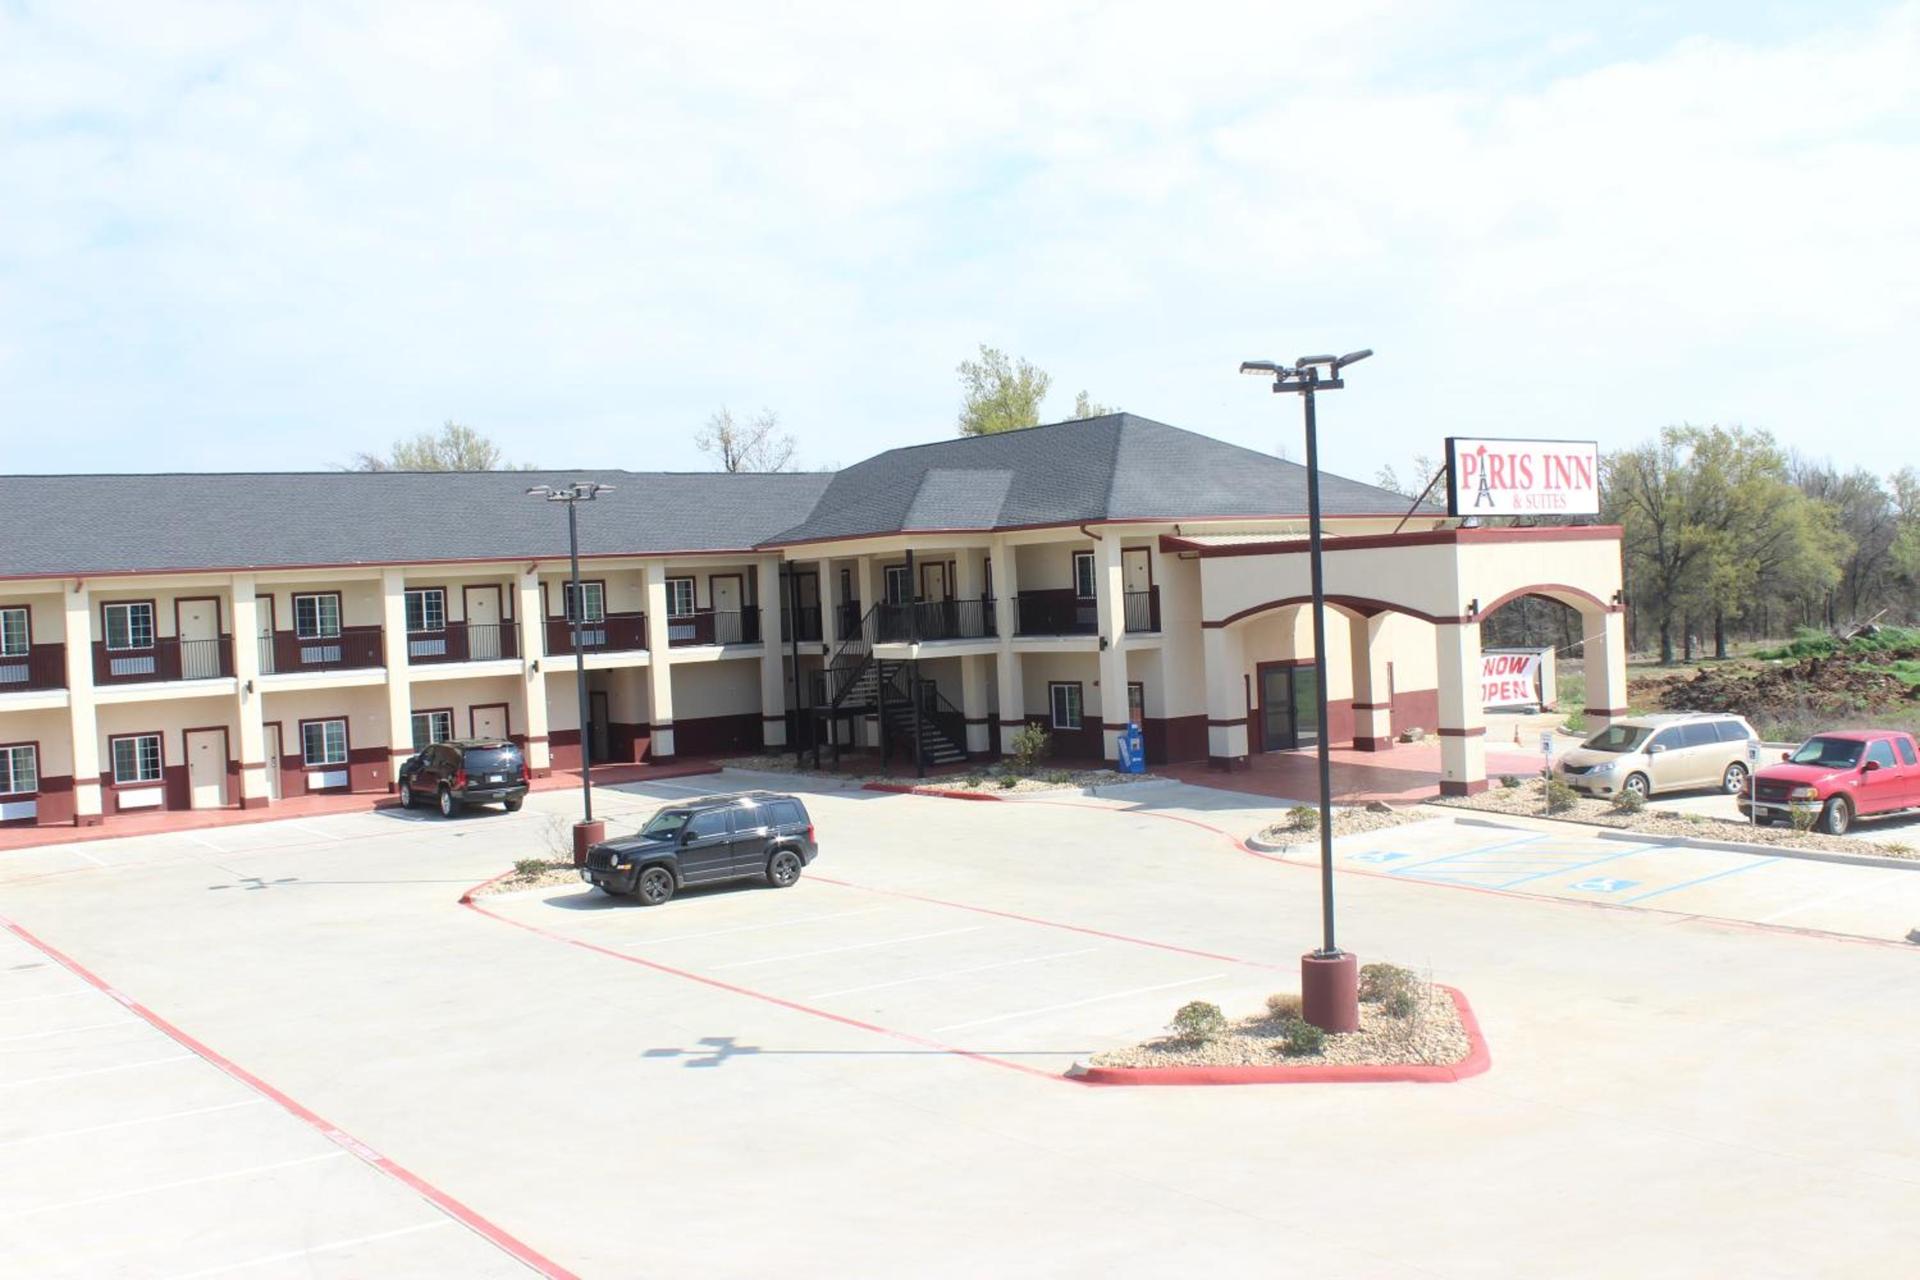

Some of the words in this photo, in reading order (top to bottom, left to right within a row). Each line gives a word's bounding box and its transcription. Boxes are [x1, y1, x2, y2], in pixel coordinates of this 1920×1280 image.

[1459, 445, 1533, 507] PARIS
[1543, 455, 1593, 490] INN
[1513, 493, 1522, 509] &
[1526, 493, 1567, 509] SUITES
[1482, 656, 1530, 677] NOW
